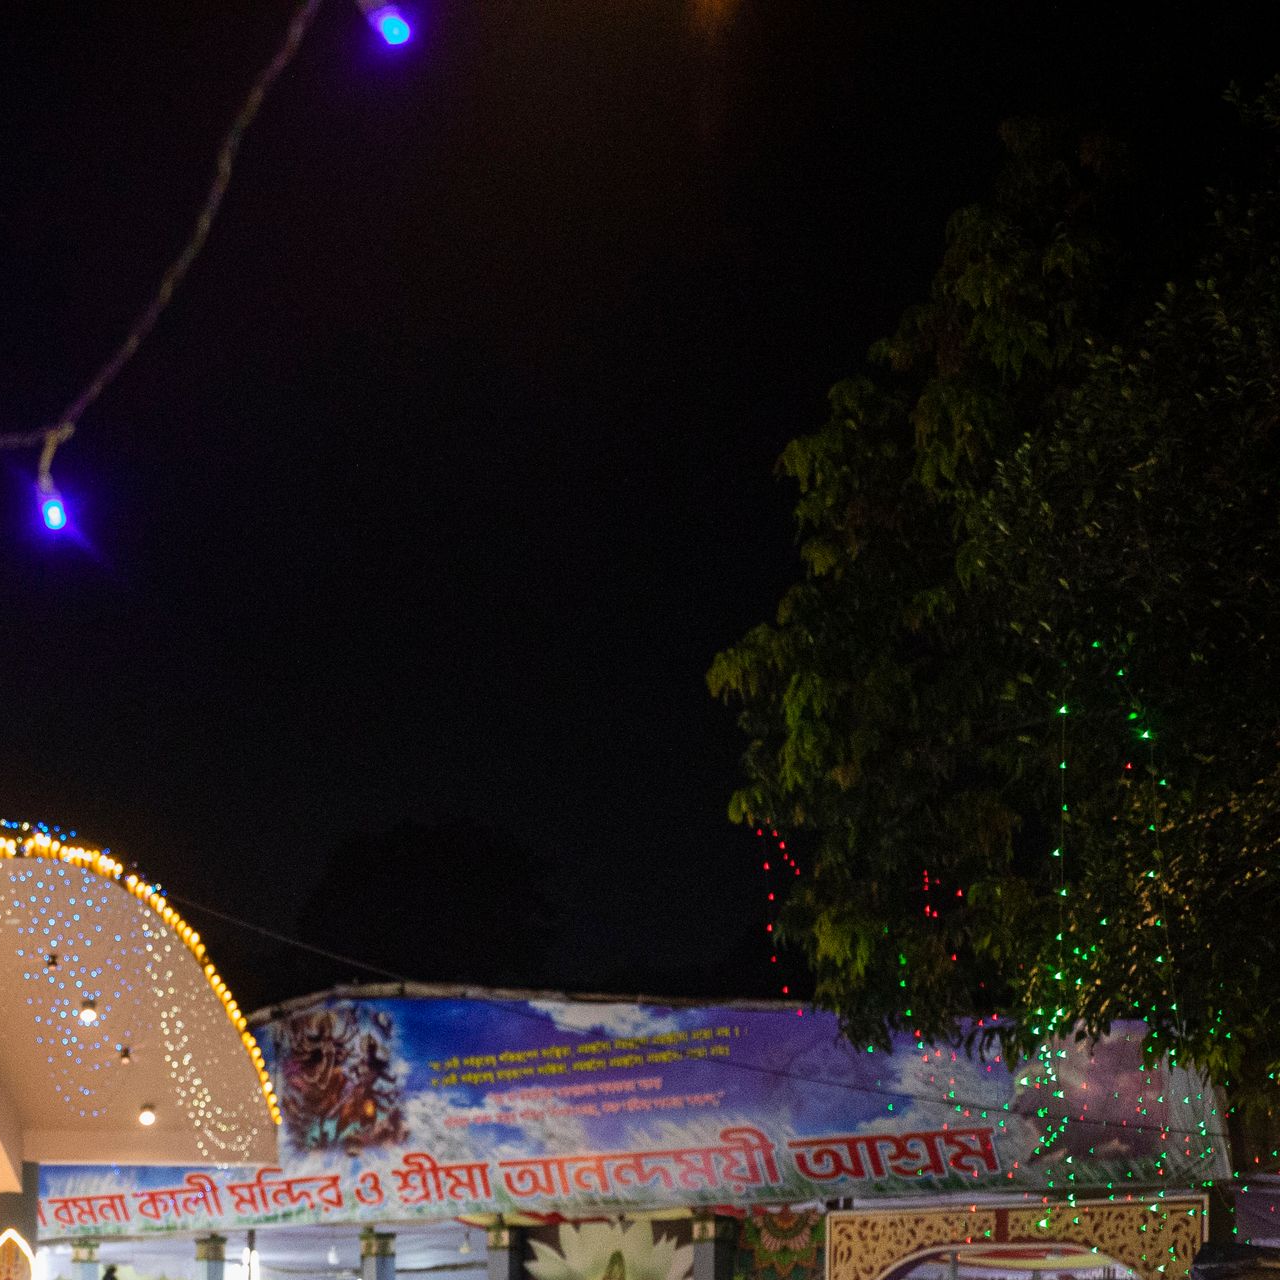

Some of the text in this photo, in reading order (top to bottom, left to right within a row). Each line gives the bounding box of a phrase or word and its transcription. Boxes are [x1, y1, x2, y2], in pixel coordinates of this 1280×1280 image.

[48, 1194, 130, 1229] রমনা
[132, 1172, 223, 1221] কালী
[226, 1167, 343, 1213] মন্দির
[355, 1172, 383, 1205] ও
[498, 1127, 777, 1196] আনন্দময়ী
[788, 1127, 998, 1179] আশ্রম
